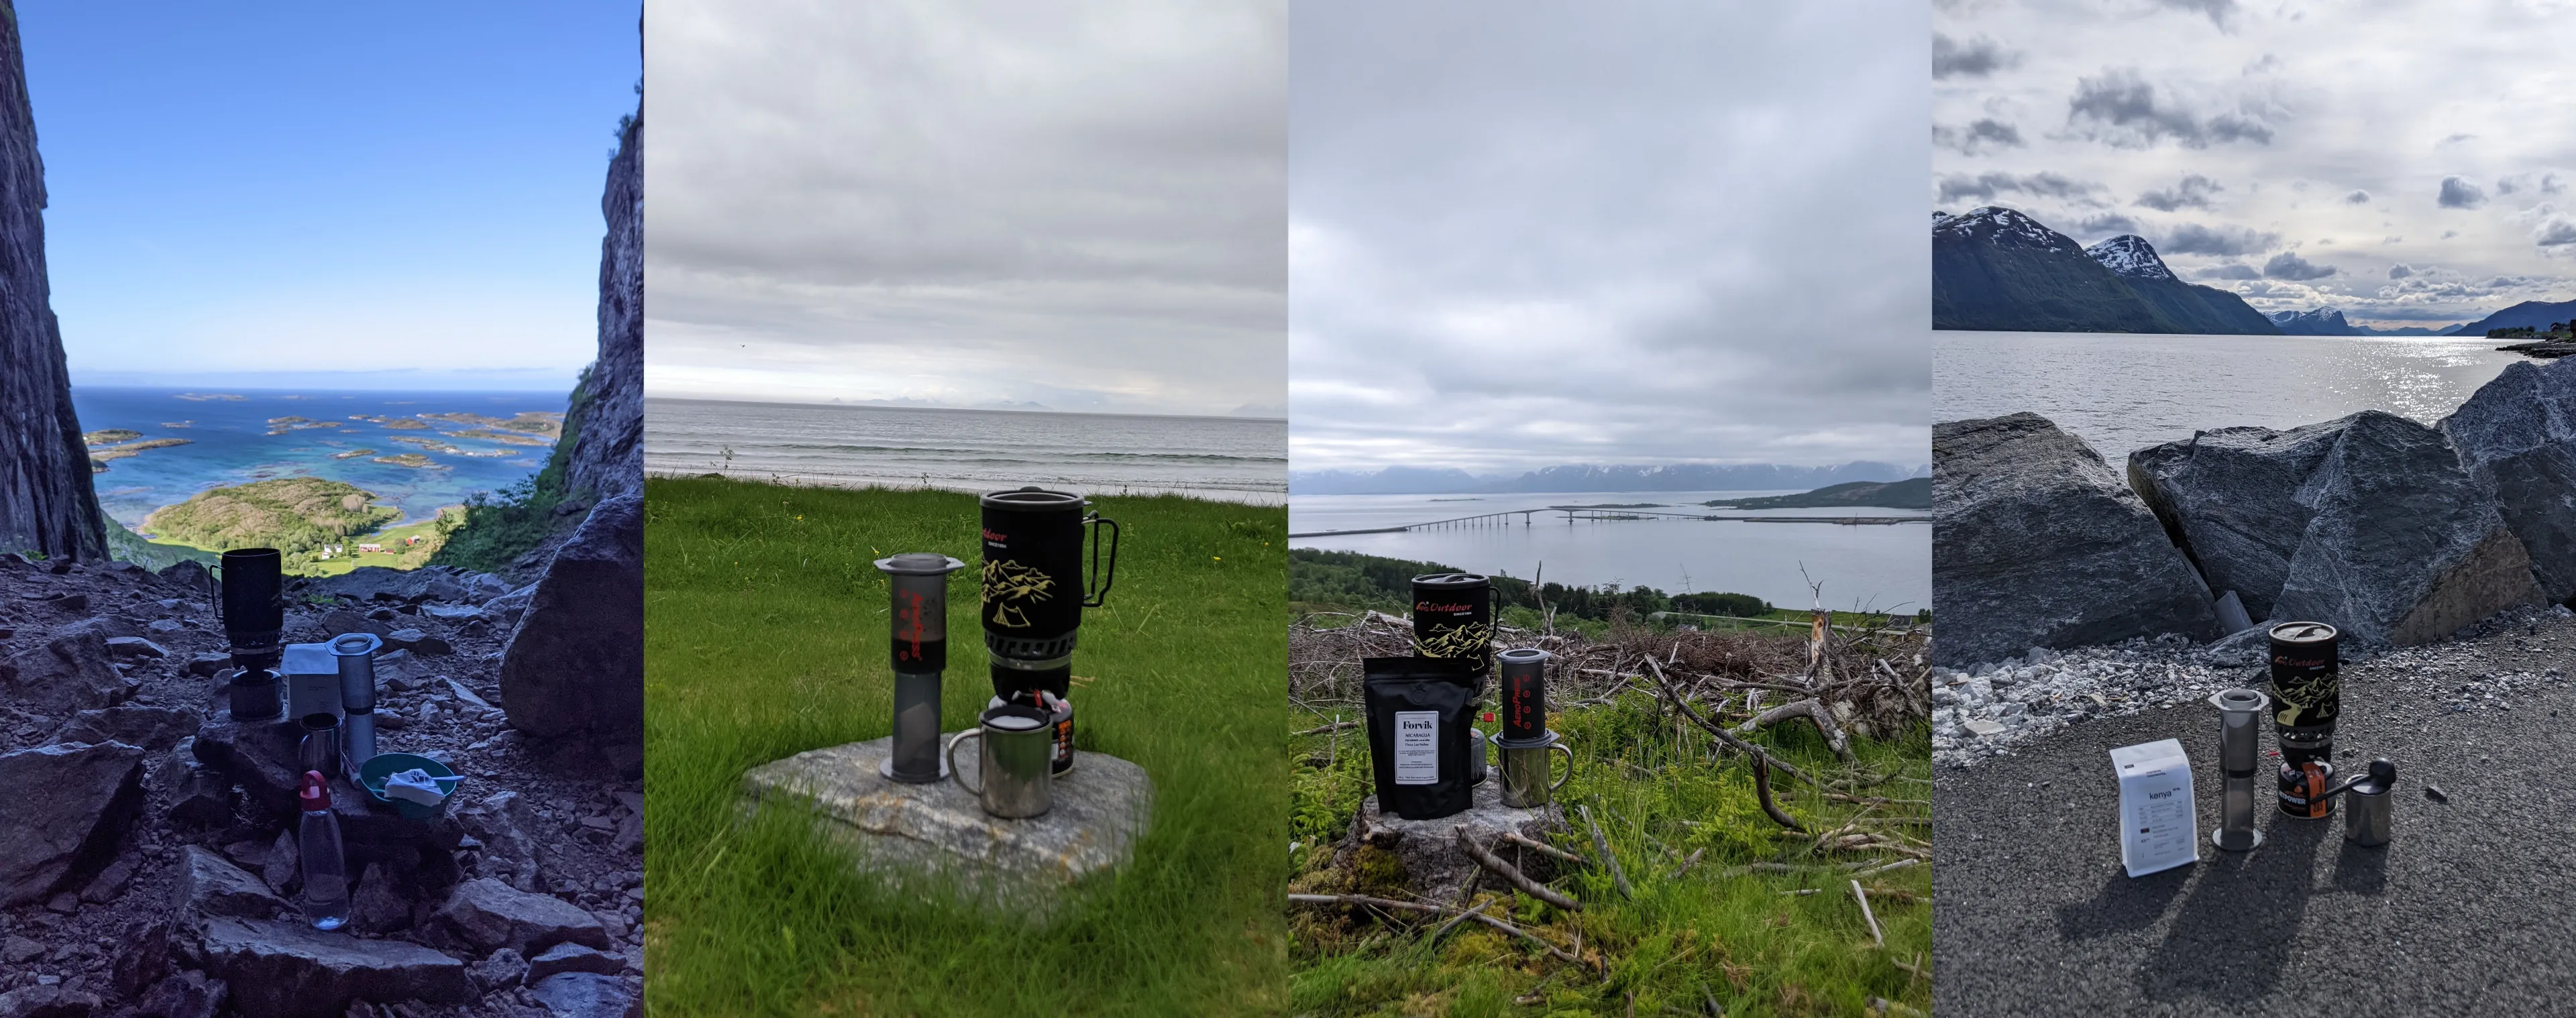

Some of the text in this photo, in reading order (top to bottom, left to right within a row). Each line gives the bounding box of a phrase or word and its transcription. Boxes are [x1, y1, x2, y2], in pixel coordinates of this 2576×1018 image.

[1430, 603, 1472, 612] Outdoor
[2289, 659, 2325, 667] Outdoor
[1403, 721, 1433, 730] Forvik
[2149, 790, 2171, 800] kenya
